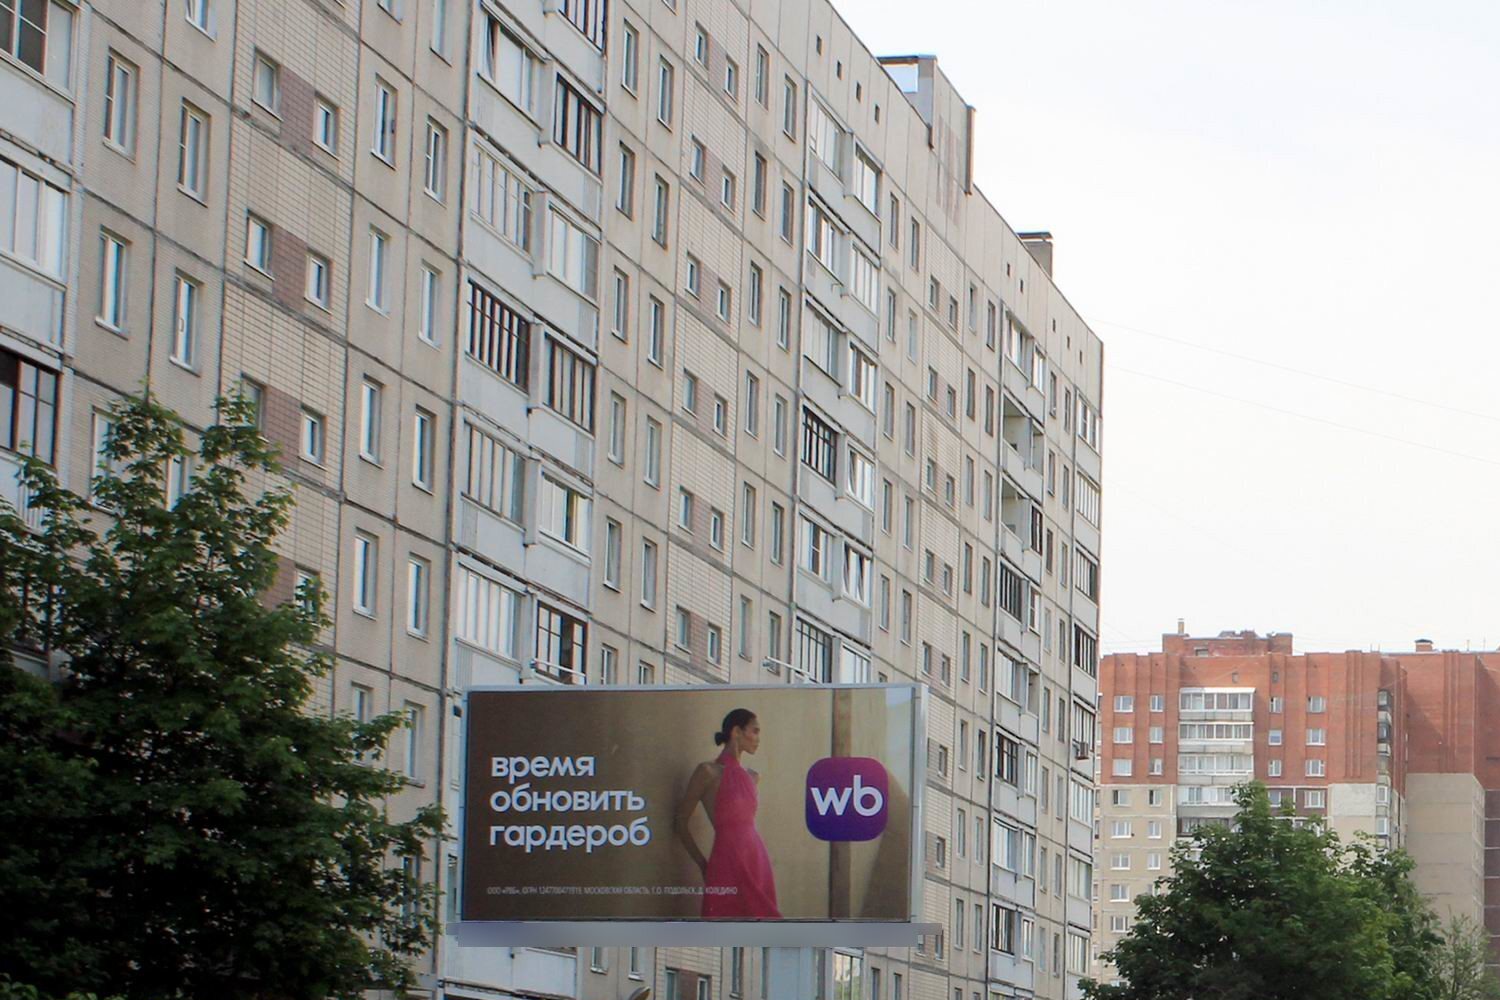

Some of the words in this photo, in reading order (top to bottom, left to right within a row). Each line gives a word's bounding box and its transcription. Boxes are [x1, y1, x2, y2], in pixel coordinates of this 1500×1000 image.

[491, 756, 595, 785] время
[490, 783, 645, 812] обновить
[810, 774, 883, 817] wb
[490, 817, 651, 853] гардероб
